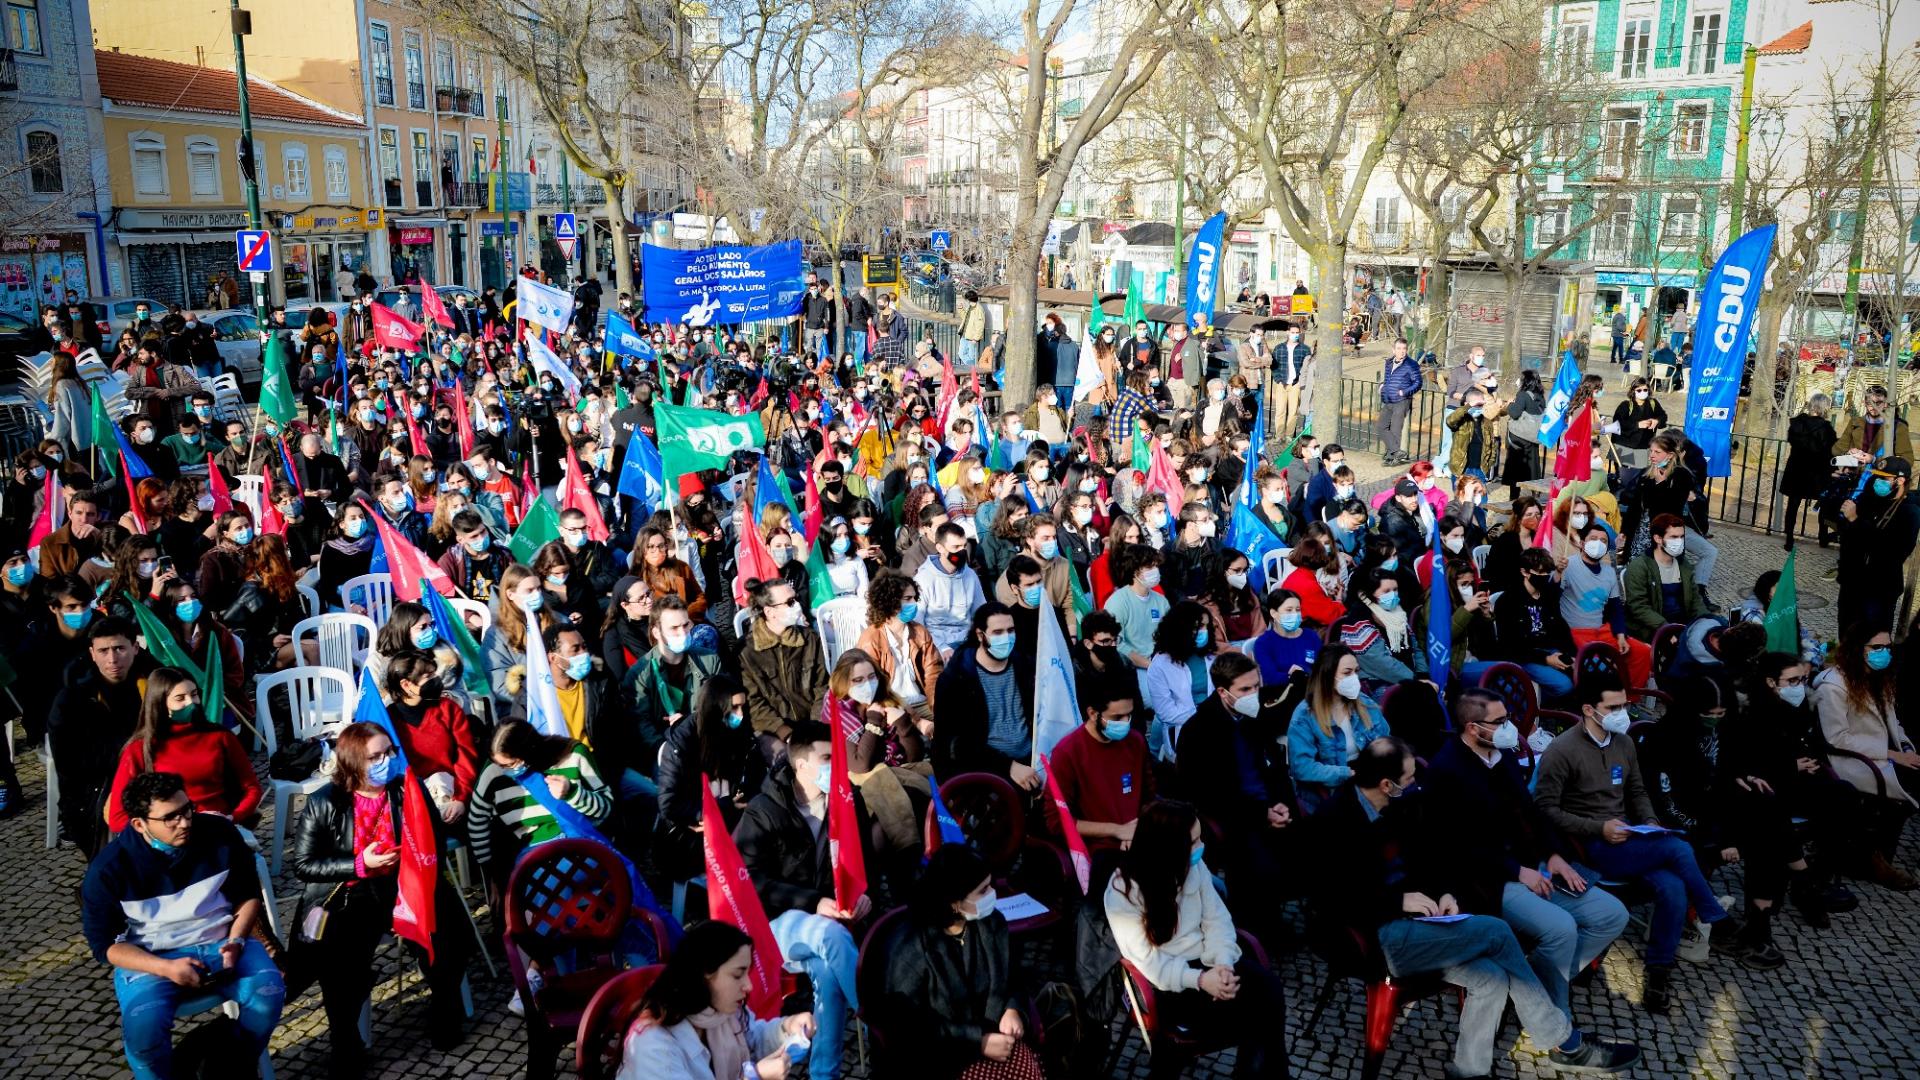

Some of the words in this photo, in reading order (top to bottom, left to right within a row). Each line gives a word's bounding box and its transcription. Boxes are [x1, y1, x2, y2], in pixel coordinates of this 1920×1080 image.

[209, 212, 247, 226] BANDEIRA
[695, 255, 706, 264] AO
[706, 254, 718, 263] TEU
[719, 252, 741, 260] LADO
[687, 263, 708, 273] PELO
[708, 261, 751, 271] AUMENTO
[675, 275, 702, 285] GERAL
[704, 272, 720, 281] DOS
[721, 269, 766, 279] SALÁRIOS
[713, 285, 737, 294] FORÇA
[746, 283, 766, 292] LUTA!
[1714, 264, 1751, 352] CDU
[640, 426, 654, 434] CNN
